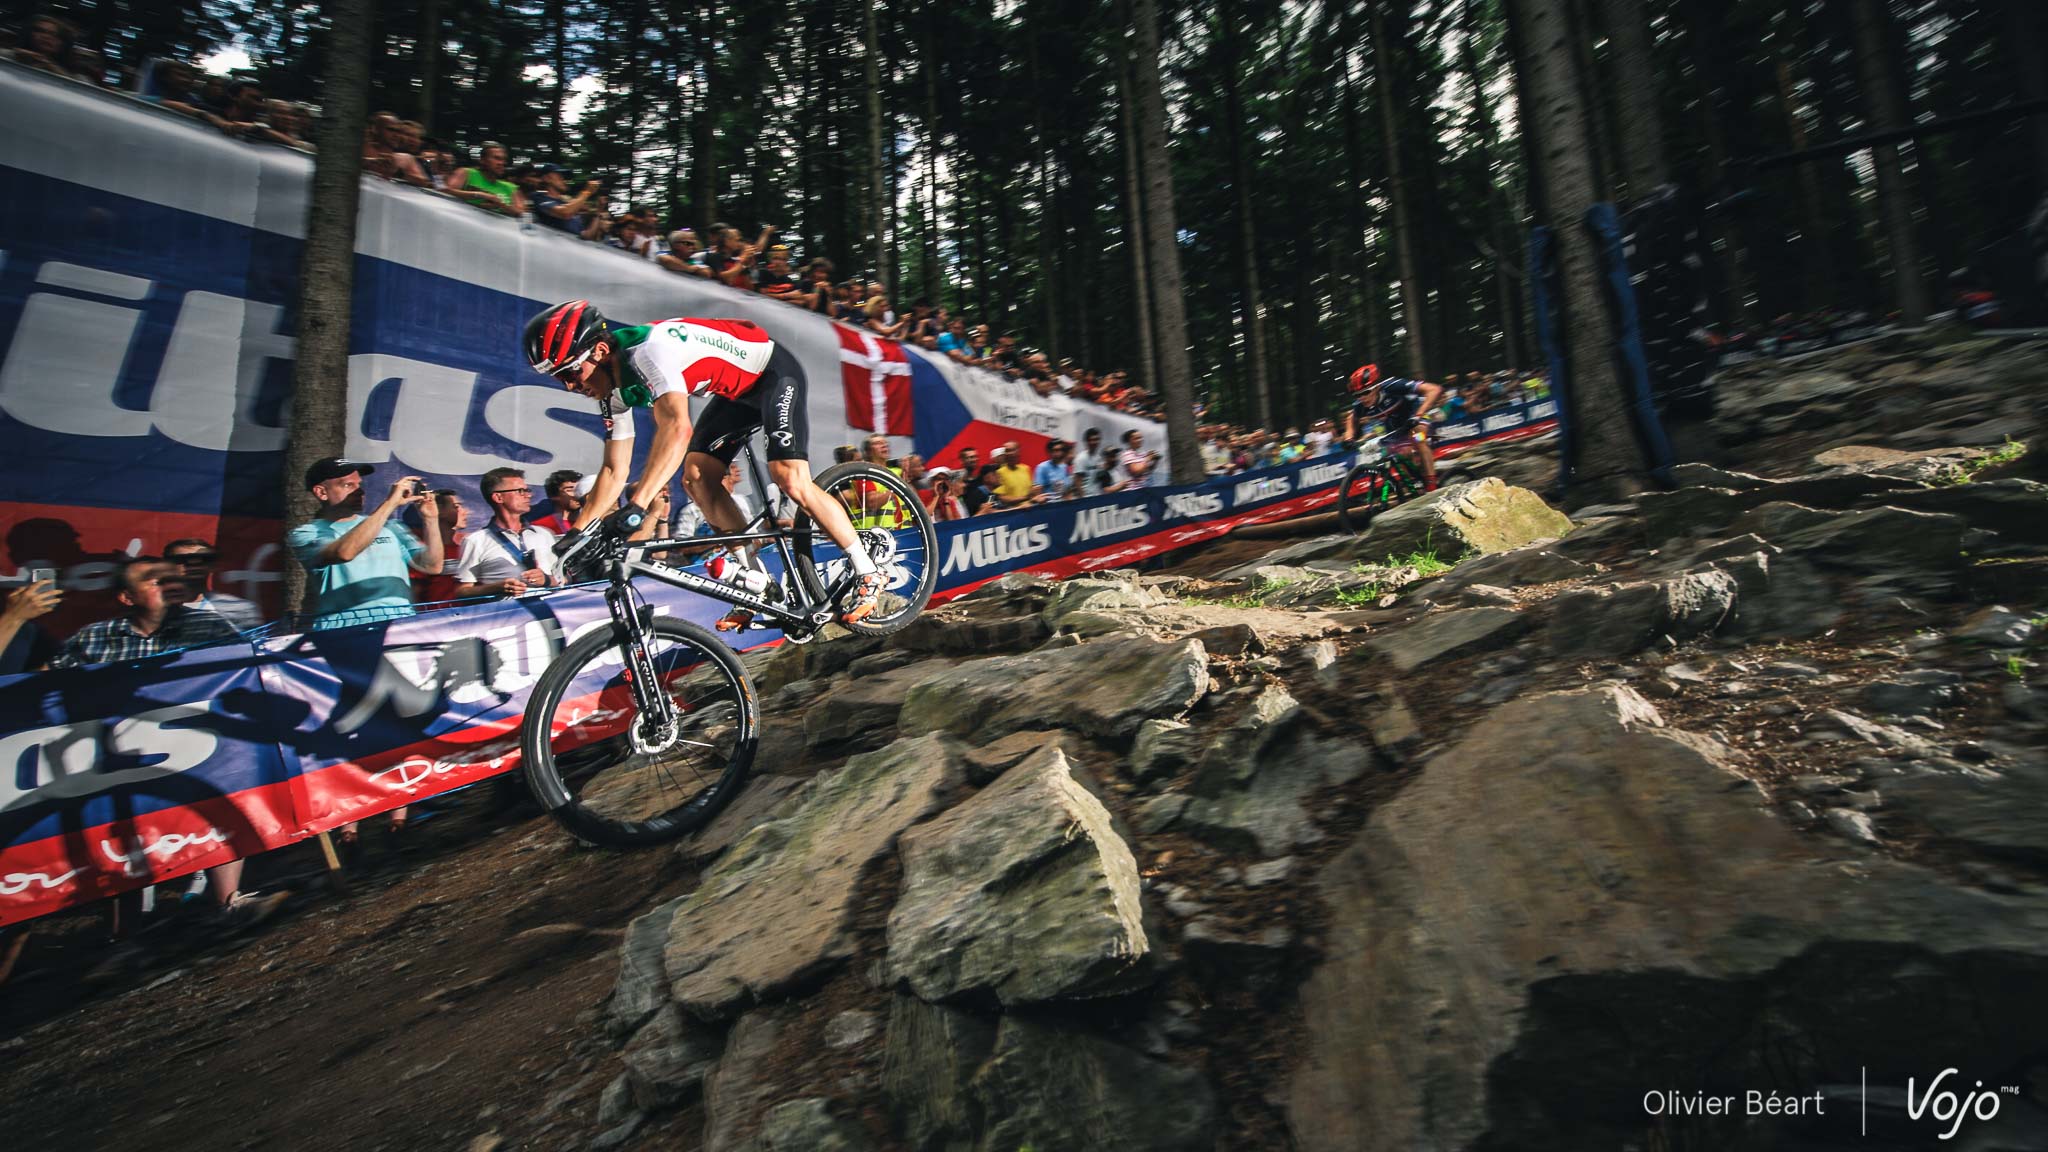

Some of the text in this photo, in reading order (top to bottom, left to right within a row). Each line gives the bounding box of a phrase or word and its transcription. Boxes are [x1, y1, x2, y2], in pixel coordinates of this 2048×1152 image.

[0, 249, 606, 487] itas
[693, 331, 748, 360] vaudoise
[776, 385, 795, 429] vaudoise
[1068, 503, 1150, 545] Mitas
[940, 522, 1051, 578] Mitas
[101, 827, 234, 878] you
